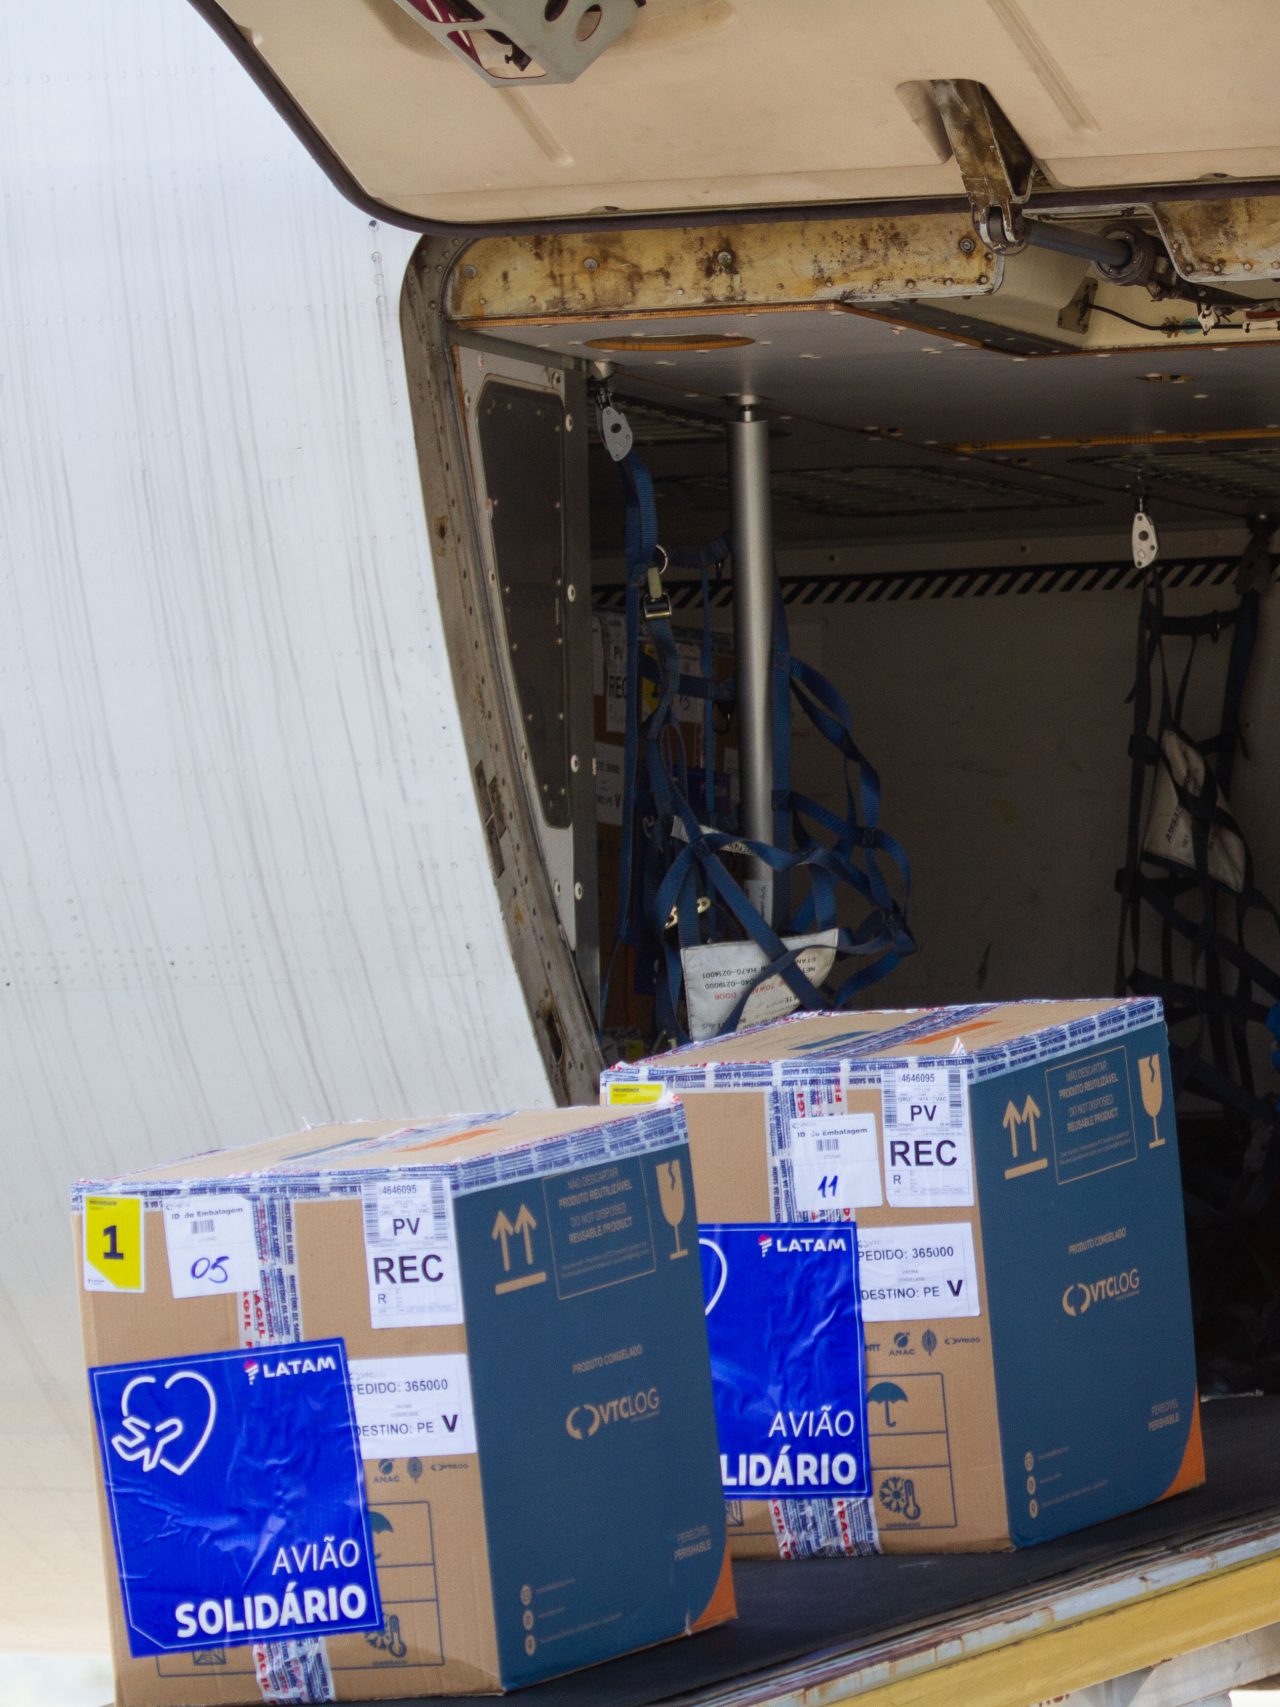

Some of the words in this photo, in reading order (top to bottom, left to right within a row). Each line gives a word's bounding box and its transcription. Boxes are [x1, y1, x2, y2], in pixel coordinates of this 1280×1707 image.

[901, 1074, 936, 1083] 4646095
[910, 1104, 937, 1122] PV
[822, 1128, 868, 1137] Embalagem
[889, 1140, 958, 1167] REC
[818, 1175, 839, 1198] 11
[893, 1174, 902, 1185] R
[382, 1184, 417, 1195] 4646095
[197, 1208, 244, 1218] Embalagem
[392, 1217, 420, 1236] PV
[103, 1225, 124, 1261] 1
[776, 1238, 846, 1253] LATAM
[912, 1246, 954, 1259] 365000
[190, 1255, 230, 1284] 05
[373, 1254, 444, 1285] REC
[860, 1287, 920, 1301] DESTINO:
[923, 1286, 940, 1298] PE
[946, 1279, 964, 1297] V
[1090, 1268, 1140, 1303] VTCLOG
[377, 1293, 386, 1304] R
[888, 1348, 915, 1356] ANAC
[262, 1356, 336, 1379] LATAM
[572, 1356, 602, 1375] PRODUTO
[404, 1379, 448, 1393] 365000
[599, 1387, 660, 1425] VTCLOG
[417, 1421, 434, 1434] PE
[442, 1414, 458, 1432] V
[768, 1405, 854, 1438] AVIÃO
[720, 1444, 857, 1487] LIDÁRIO
[272, 1536, 360, 1576] AVIÃO
[175, 1582, 367, 1639] SOLIDÁRIO
